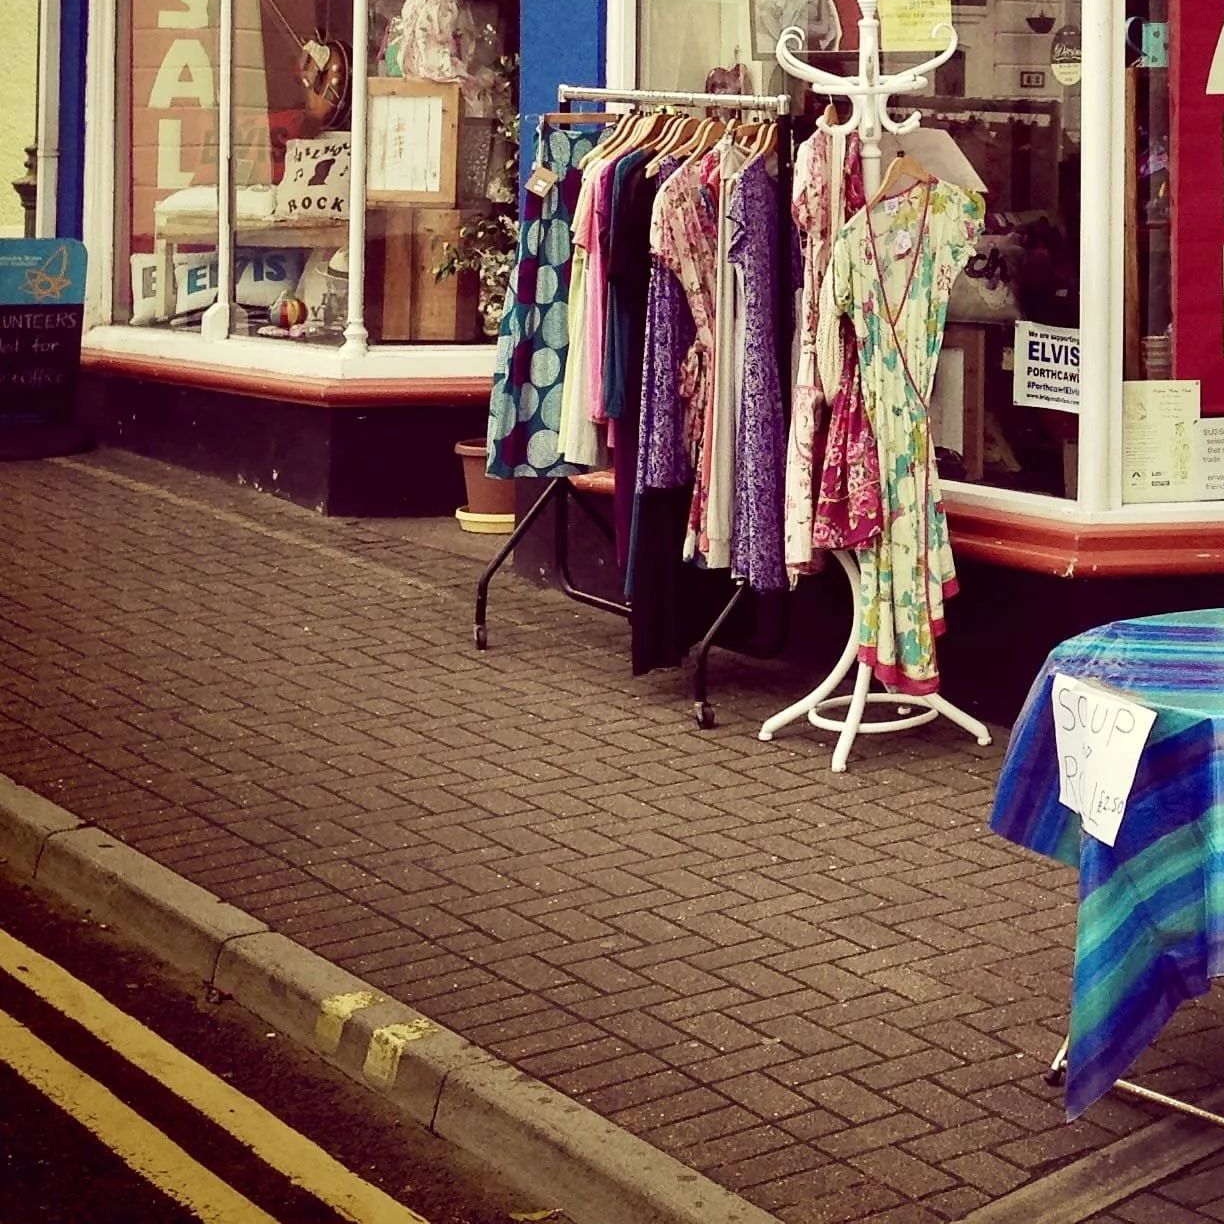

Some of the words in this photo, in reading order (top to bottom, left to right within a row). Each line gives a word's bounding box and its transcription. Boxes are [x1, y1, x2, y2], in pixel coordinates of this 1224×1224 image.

[203, 126, 288, 164] EVIS
[288, 197, 344, 213] ROCK
[0, 312, 77, 330] UNTEERS
[1028, 340, 1080, 367] ELVIS
[1058, 687, 1136, 748] SOUP
